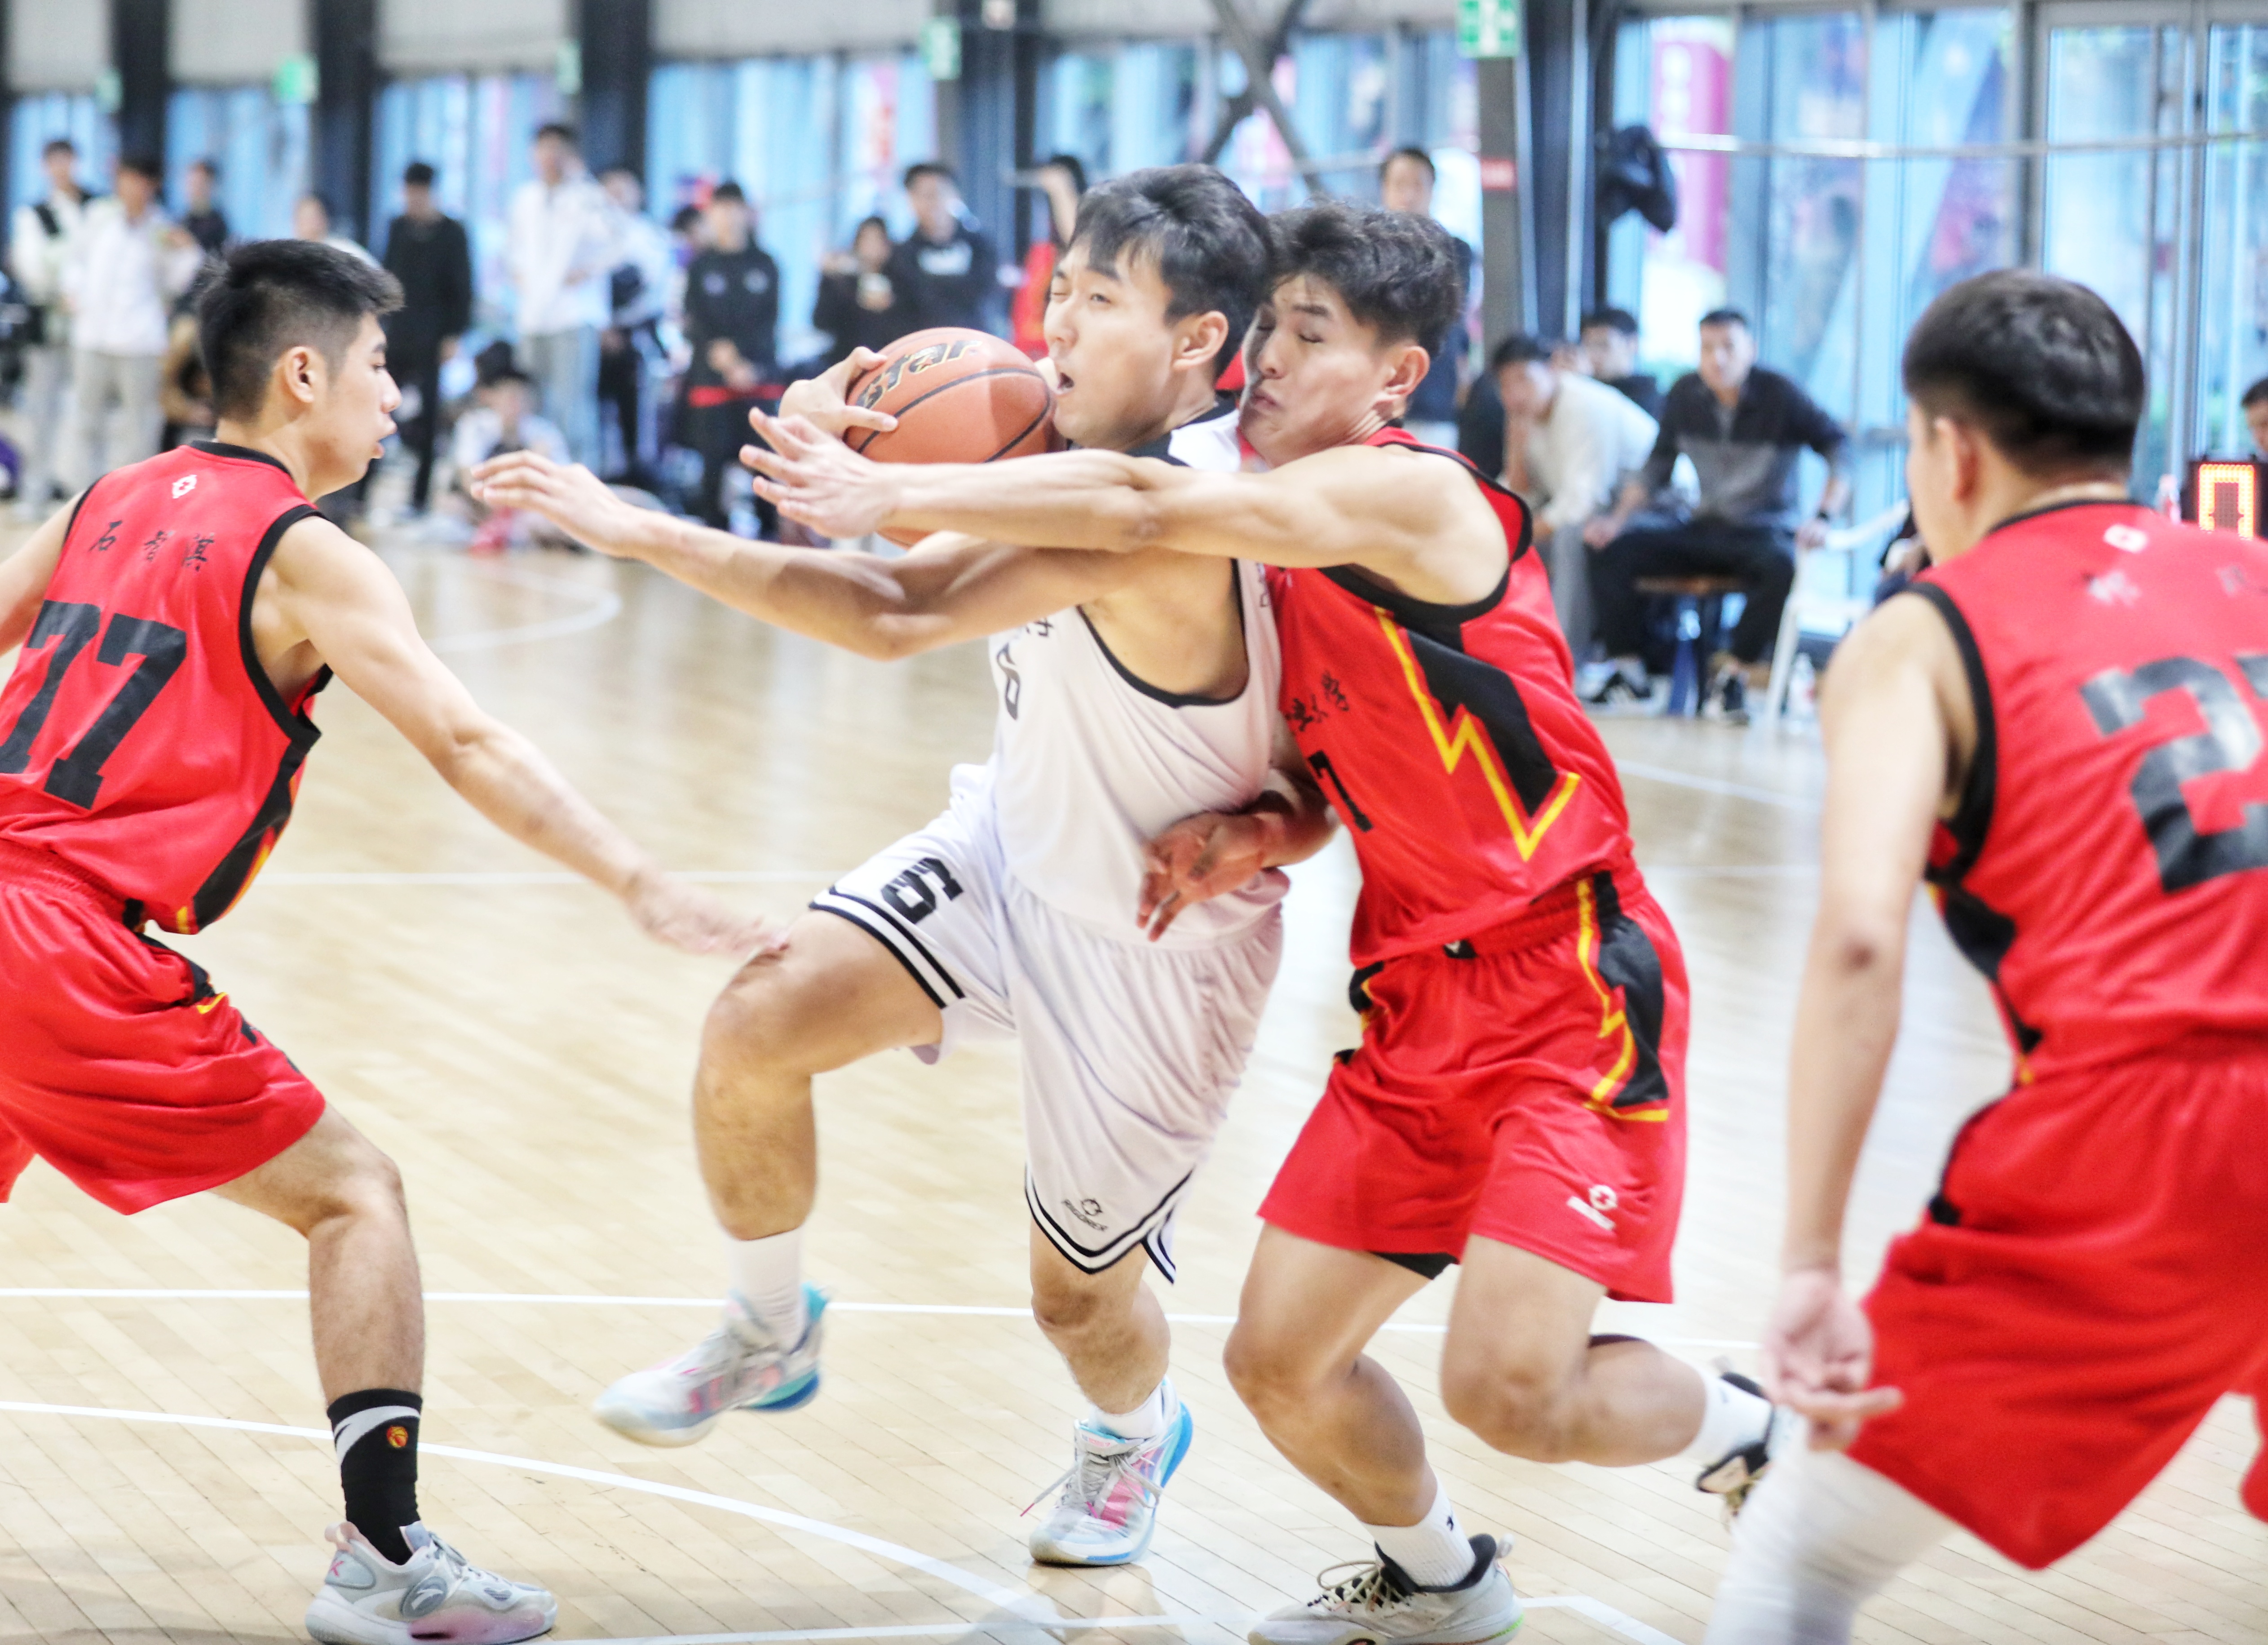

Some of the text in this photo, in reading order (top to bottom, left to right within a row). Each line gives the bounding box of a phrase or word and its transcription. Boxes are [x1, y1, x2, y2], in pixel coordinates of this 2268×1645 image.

[0, 600, 186, 810] 77
[2080, 654, 2268, 893] 2
[880, 857, 964, 925] 6
